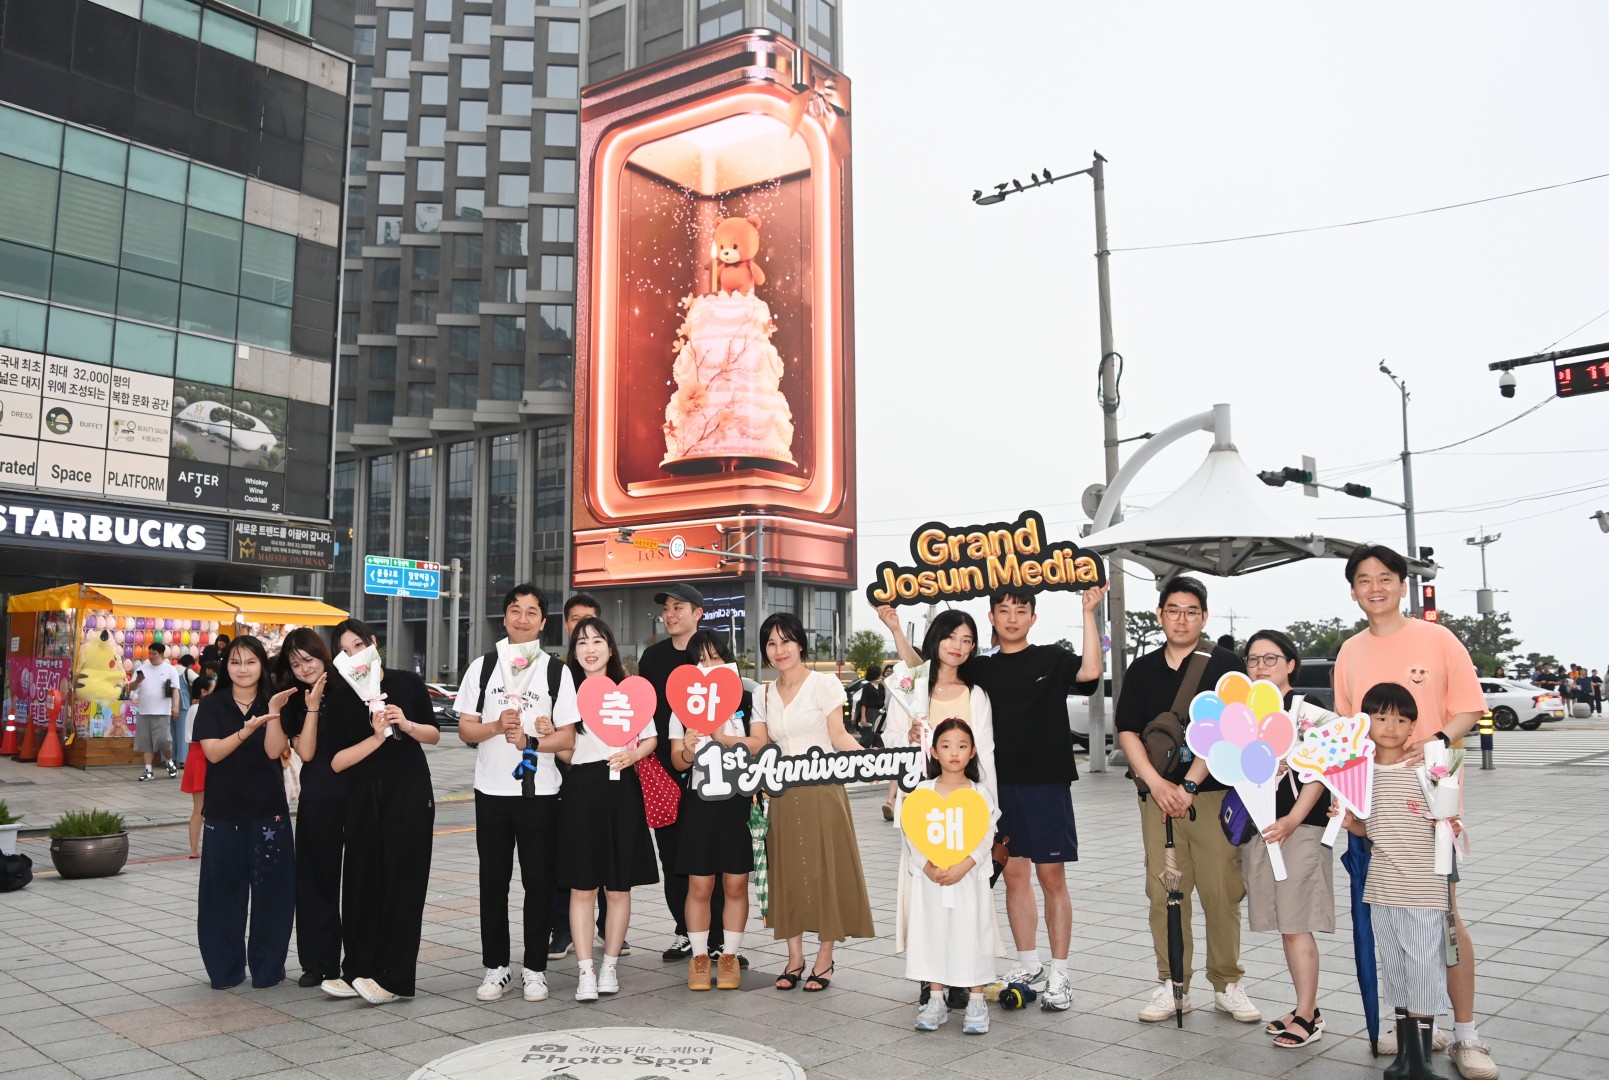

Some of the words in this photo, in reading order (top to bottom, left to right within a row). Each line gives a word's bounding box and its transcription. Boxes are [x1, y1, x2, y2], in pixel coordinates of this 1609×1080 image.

[0, 355, 20, 370] 국내
[21, 358, 41, 372] 최초
[49, 363, 68, 378] 최대
[73, 367, 109, 384] 32,000
[112, 375, 130, 389] 평의
[21, 375, 41, 390] 대지
[47, 379, 67, 394] 위에
[69, 383, 106, 400] 조성되는
[112, 391, 130, 404] 복합
[132, 394, 150, 408] 문화
[151, 397, 169, 411] 공간
[11, 410, 33, 419] DRESS
[79, 420, 104, 430] BUFFET
[137, 424, 154, 433] BEAUTY
[154, 427, 169, 435] SALON
[141, 435, 163, 443] K-BEAUTY
[0, 461, 35, 476] rated
[51, 464, 92, 483] Space
[107, 471, 165, 492] PLATFORM
[178, 471, 219, 487] AFTER
[244, 477, 269, 487] Whiskey
[193, 485, 202, 498] 9
[248, 486, 264, 495] Wine
[244, 495, 268, 503] Cocktail
[271, 503, 281, 511] 2F
[235, 522, 258, 535] 새로운
[288, 528, 309, 541] 이끌어
[309, 531, 333, 544] 갑니다.
[674, 543, 683, 553] 50
[916, 517, 1041, 566] Grand
[257, 552, 289, 563] MAJESTIC
[290, 555, 305, 564] ONE
[305, 557, 326, 566] BUSAN
[873, 567, 984, 603] Josun
[986, 547, 1099, 590] Media
[686, 682, 721, 722] 하
[598, 690, 635, 732] 축
[699, 744, 748, 797] 1st
[737, 746, 923, 793] Anniversary
[925, 806, 963, 851] 해
[520, 1053, 624, 1064] Photo
[631, 1055, 714, 1067] Spot
